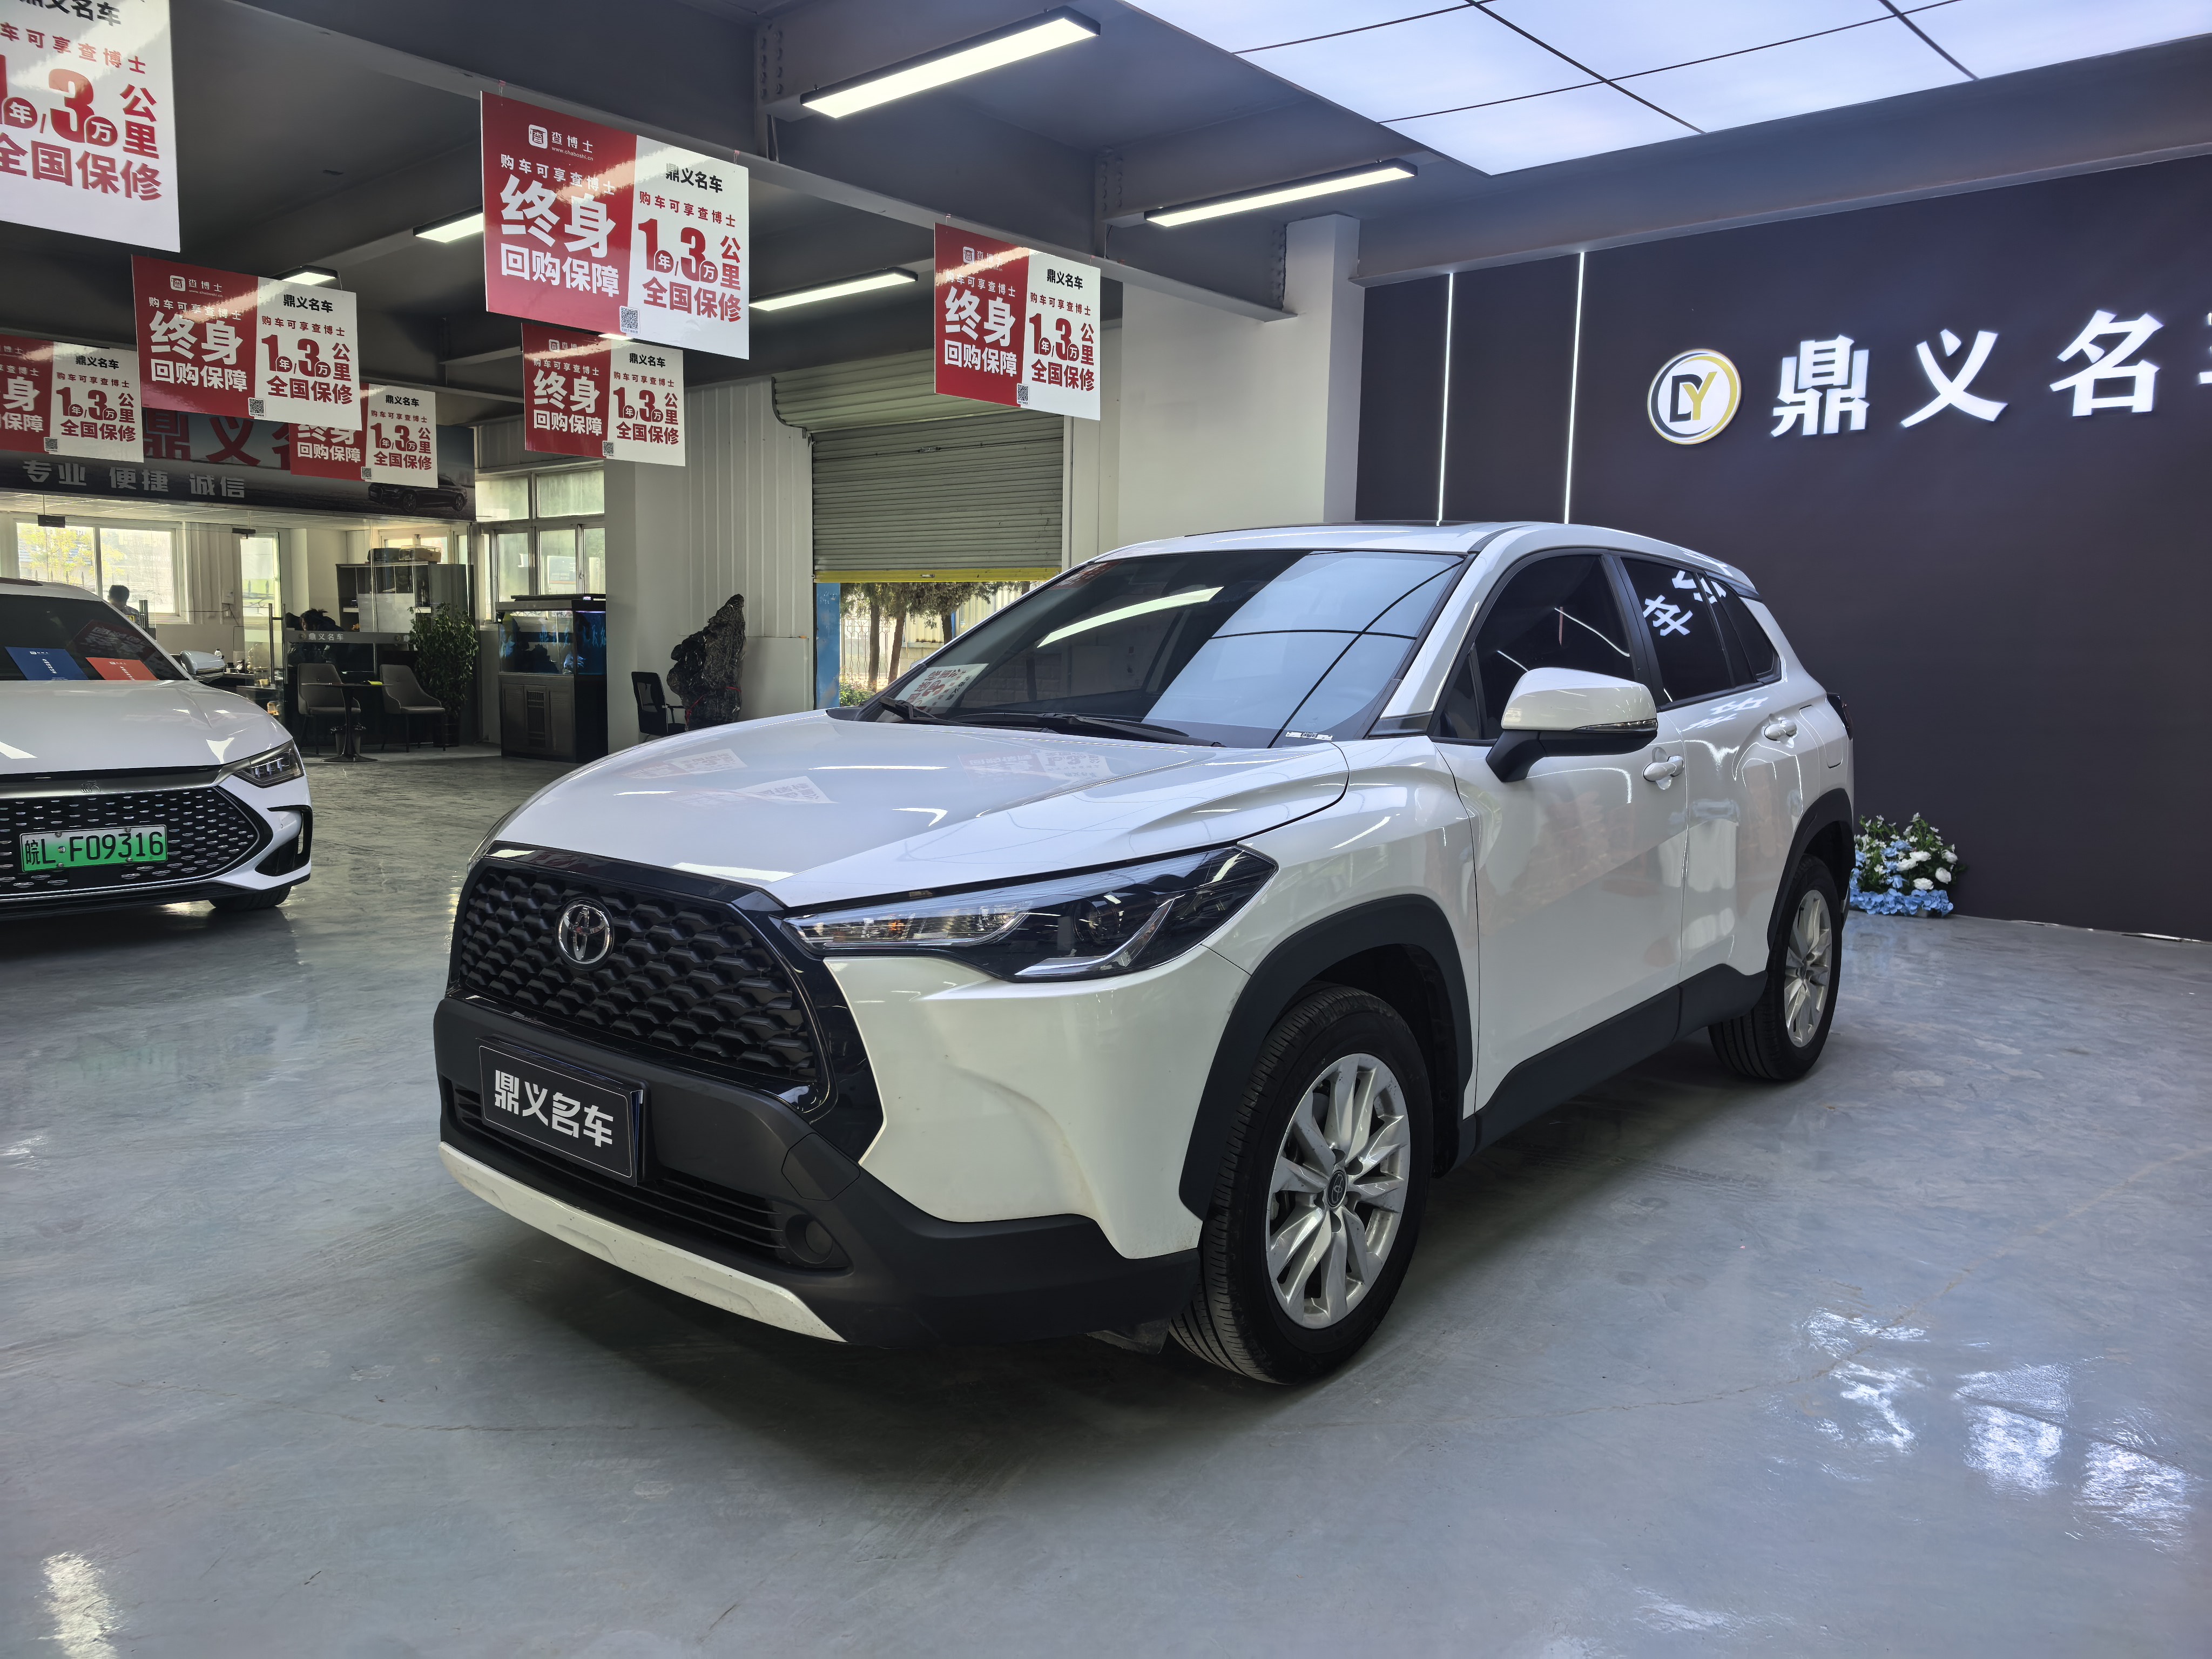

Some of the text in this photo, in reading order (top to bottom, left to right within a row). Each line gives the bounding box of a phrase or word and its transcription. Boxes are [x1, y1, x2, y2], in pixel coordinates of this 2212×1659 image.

[551, 131, 593, 153] 查博士
[500, 154, 615, 195] 购车可享查博士
[665, 163, 723, 193] 鼎义名车
[500, 174, 616, 258] 终身
[639, 191, 736, 227] 购车可享查博士
[501, 242, 620, 298] 回购保障
[1047, 268, 1083, 290] 鼎义名车
[946, 271, 1016, 297] 购车可享查博士
[149, 296, 241, 321] 购车可享查博士
[283, 294, 333, 313] 鼎义名车
[642, 276, 741, 322] 全国保修
[1030, 292, 1091, 316] 购车可享查博士
[261, 315, 346, 337] 购车可享查博士
[945, 286, 1016, 347] 终身
[149, 311, 244, 365] 终身
[75, 355, 119, 369] 鼎义名车
[533, 358, 599, 376] 购车可享查博士
[629, 353, 666, 368] 鼎义名车
[944, 339, 1017, 377] 回购保障
[56, 372, 130, 388] 购车可享查博士
[150, 359, 248, 393] 回购保障
[613, 371, 675, 388] 购车可享查博士
[1031, 359, 1095, 392] 全国保修
[1770, 309, 2212, 437] 鼎义名
[266, 375, 353, 405] 全国保修
[386, 395, 420, 407] 鼎义名车
[533, 369, 600, 414] 终身
[371, 410, 428, 423] 购车可享查博士
[533, 409, 603, 436] 回购保障
[60, 419, 136, 442] 全国保修
[616, 421, 679, 445] 全国保修
[297, 442, 361, 463] 回购保障
[373, 451, 432, 470] 全国保修
[22, 460, 246, 498] 专业 便捷 诚信
[495, 1069, 614, 1148] 鼎义名车
